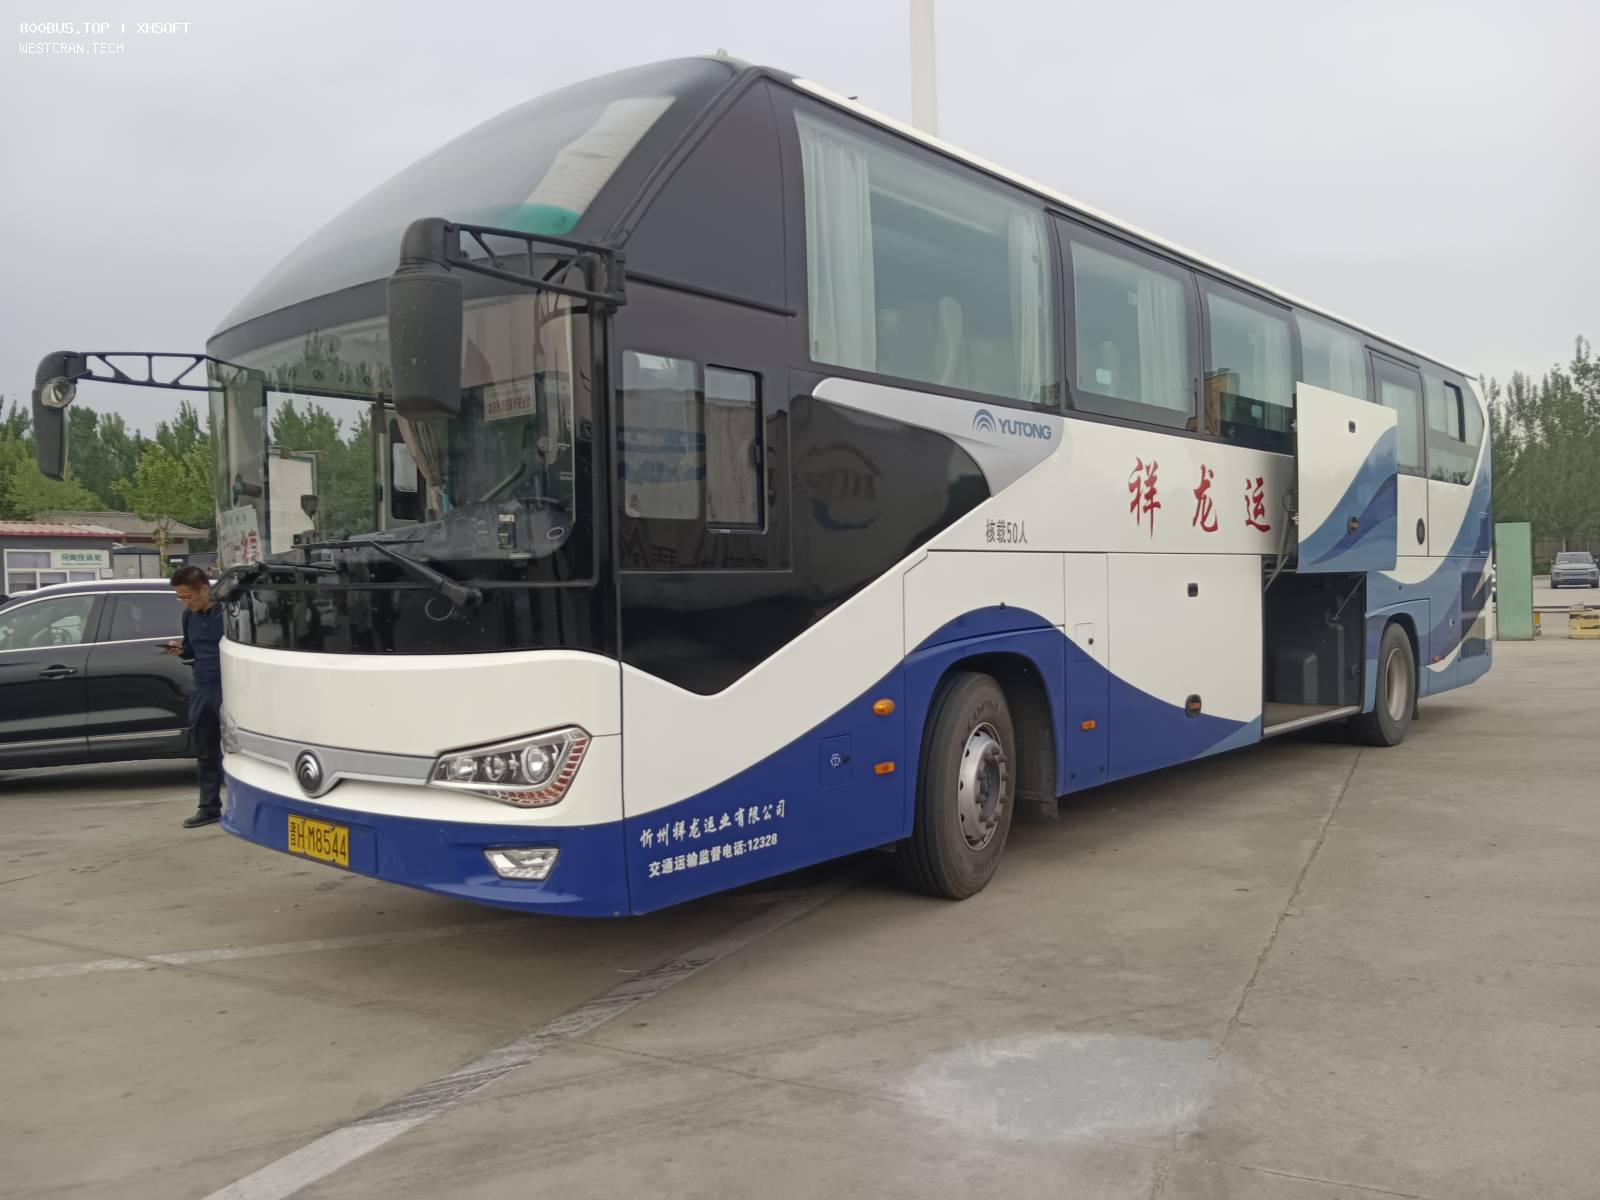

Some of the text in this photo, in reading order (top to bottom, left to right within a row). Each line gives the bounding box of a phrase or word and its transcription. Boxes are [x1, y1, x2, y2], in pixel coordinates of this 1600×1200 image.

[997, 418, 1052, 440] YUTONG
[985, 518, 1028, 545] 核载50人
